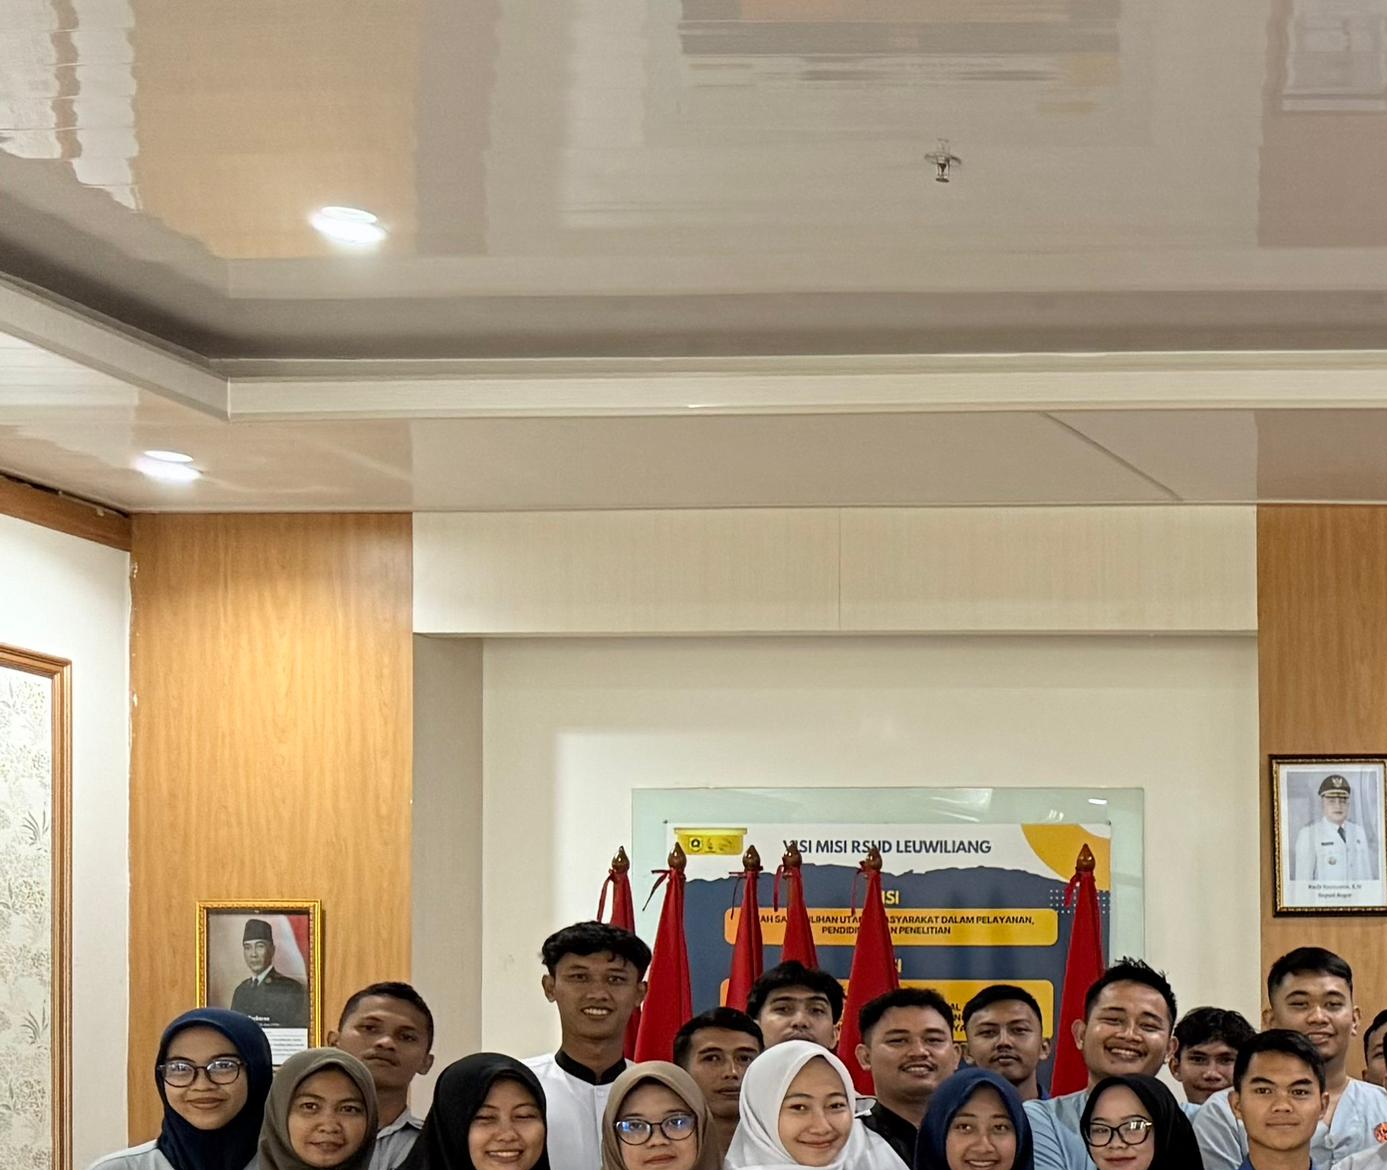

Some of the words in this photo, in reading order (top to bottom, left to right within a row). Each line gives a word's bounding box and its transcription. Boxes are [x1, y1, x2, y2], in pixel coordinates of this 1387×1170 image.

[815, 840, 847, 853] MISI
[896, 840, 991, 853] LEUWILIANG
[941, 916, 974, 924] DALAM
[976, 916, 1034, 925] PELAYANAN,
